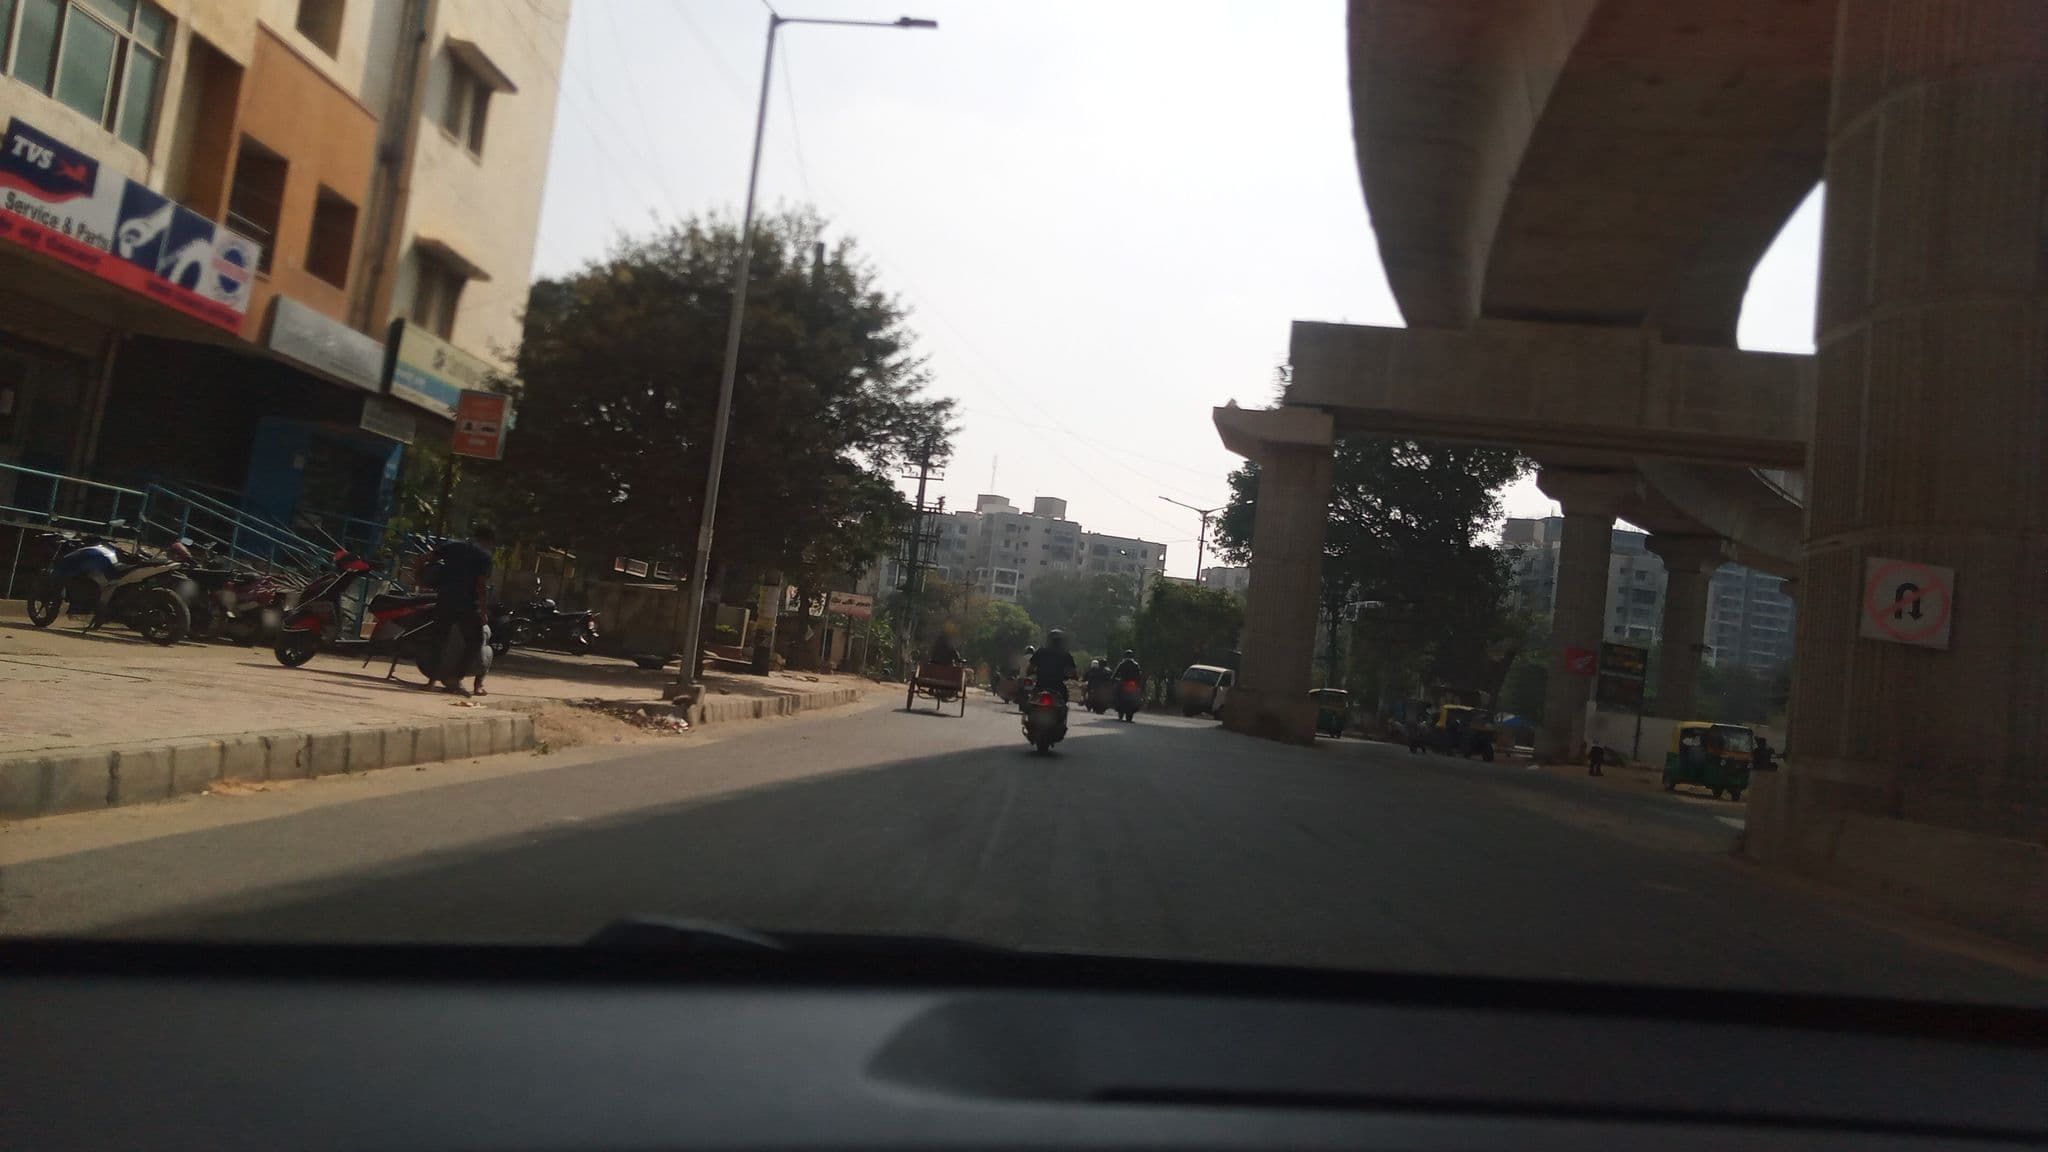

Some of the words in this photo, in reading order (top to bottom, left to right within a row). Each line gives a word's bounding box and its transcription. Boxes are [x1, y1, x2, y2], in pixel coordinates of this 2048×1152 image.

[11, 134, 56, 169] TVS
[5, 191, 59, 229] Service
[62, 216, 73, 235] &
